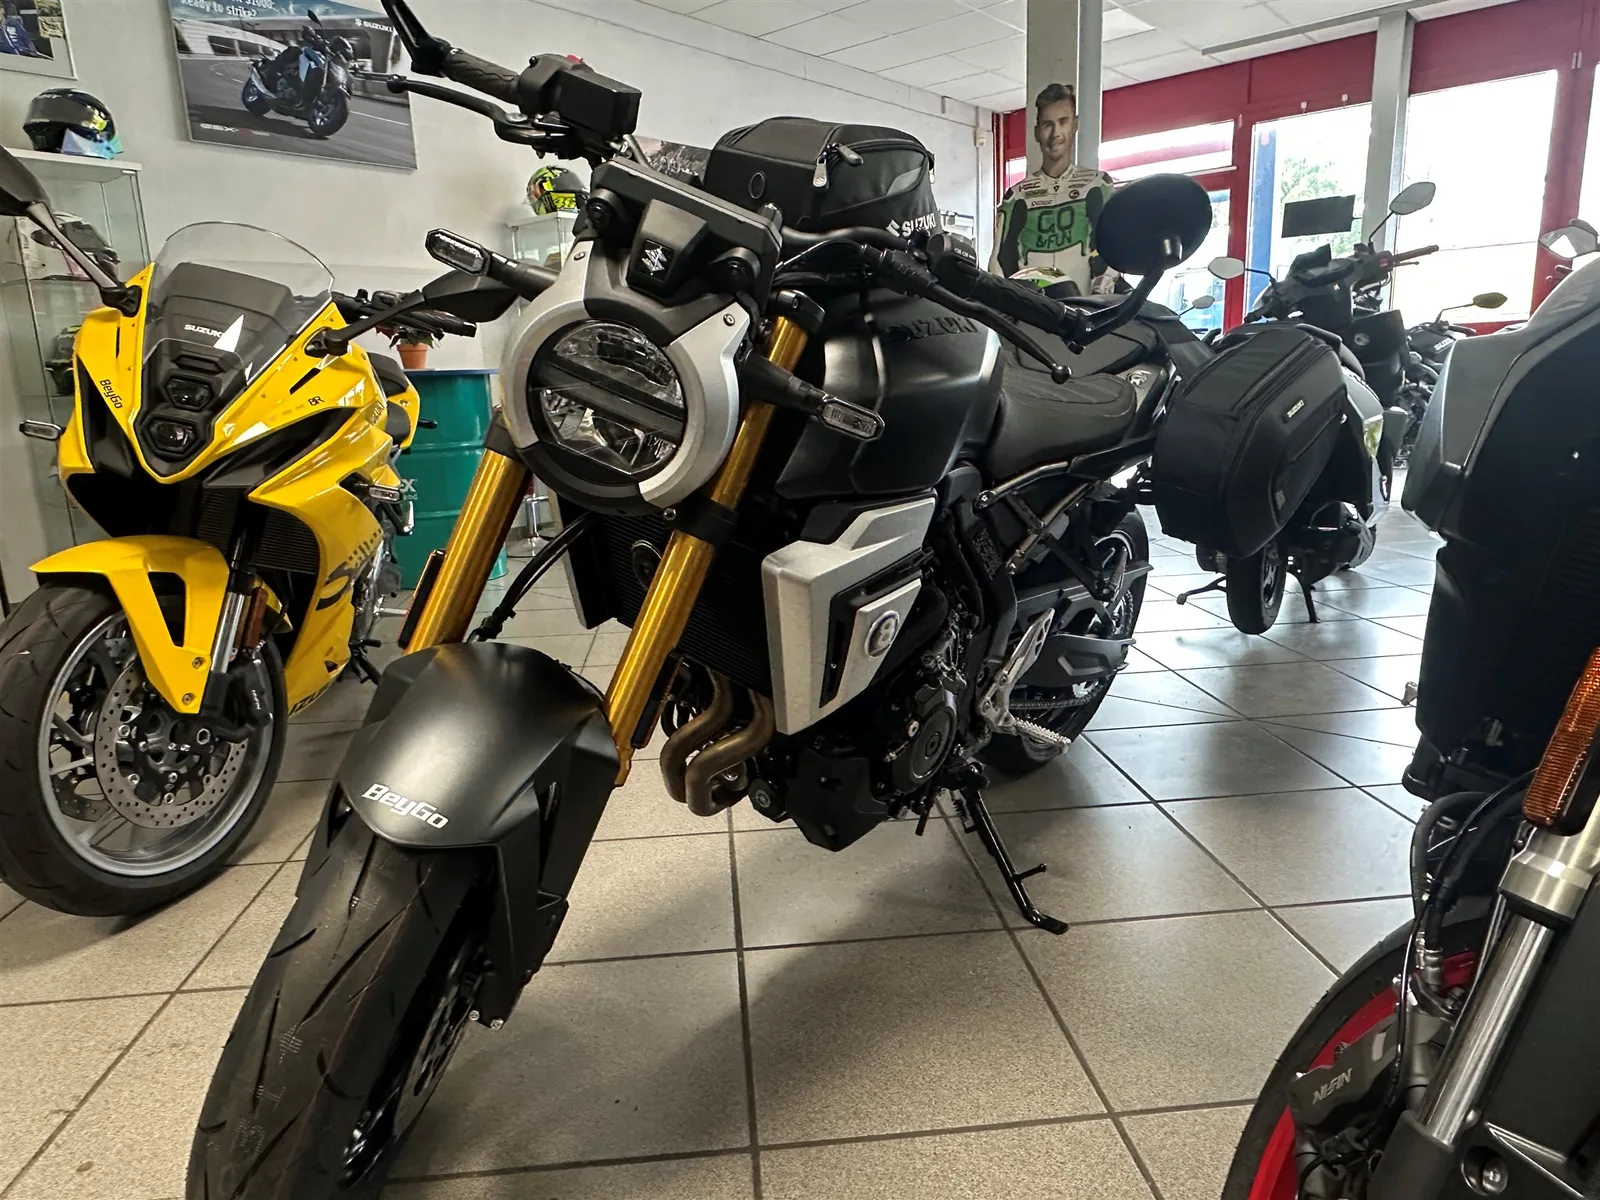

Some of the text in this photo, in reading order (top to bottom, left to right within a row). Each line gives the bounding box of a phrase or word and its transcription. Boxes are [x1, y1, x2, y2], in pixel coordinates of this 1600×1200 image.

[1038, 206, 1074, 233] GO
[183, 324, 223, 338] SUZUK
[100, 379, 123, 409] BeyGo
[361, 783, 449, 829] BeyGo
